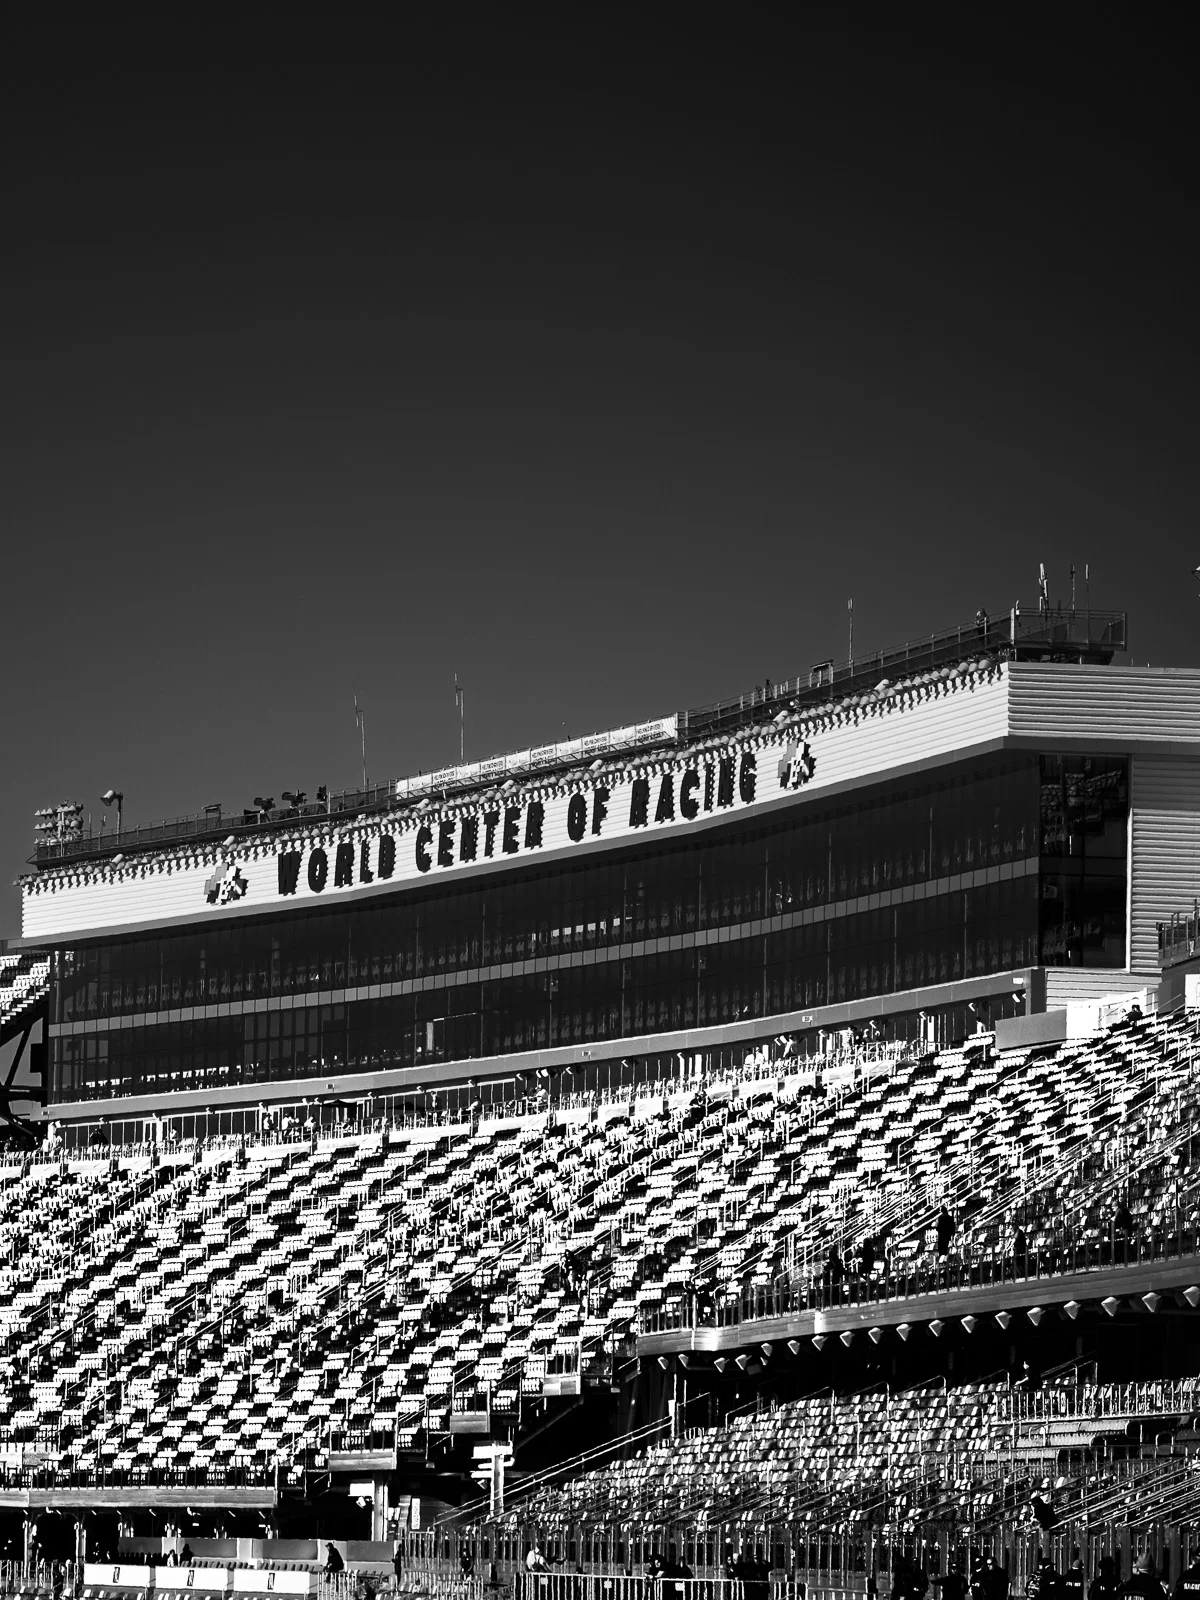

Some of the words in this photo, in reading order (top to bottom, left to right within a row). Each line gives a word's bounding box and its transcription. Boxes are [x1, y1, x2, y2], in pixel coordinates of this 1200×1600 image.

[278, 834, 396, 896] WORLD
[415, 801, 545, 872] CENTER
[568, 784, 611, 842] OF
[630, 752, 757, 827] RACING
